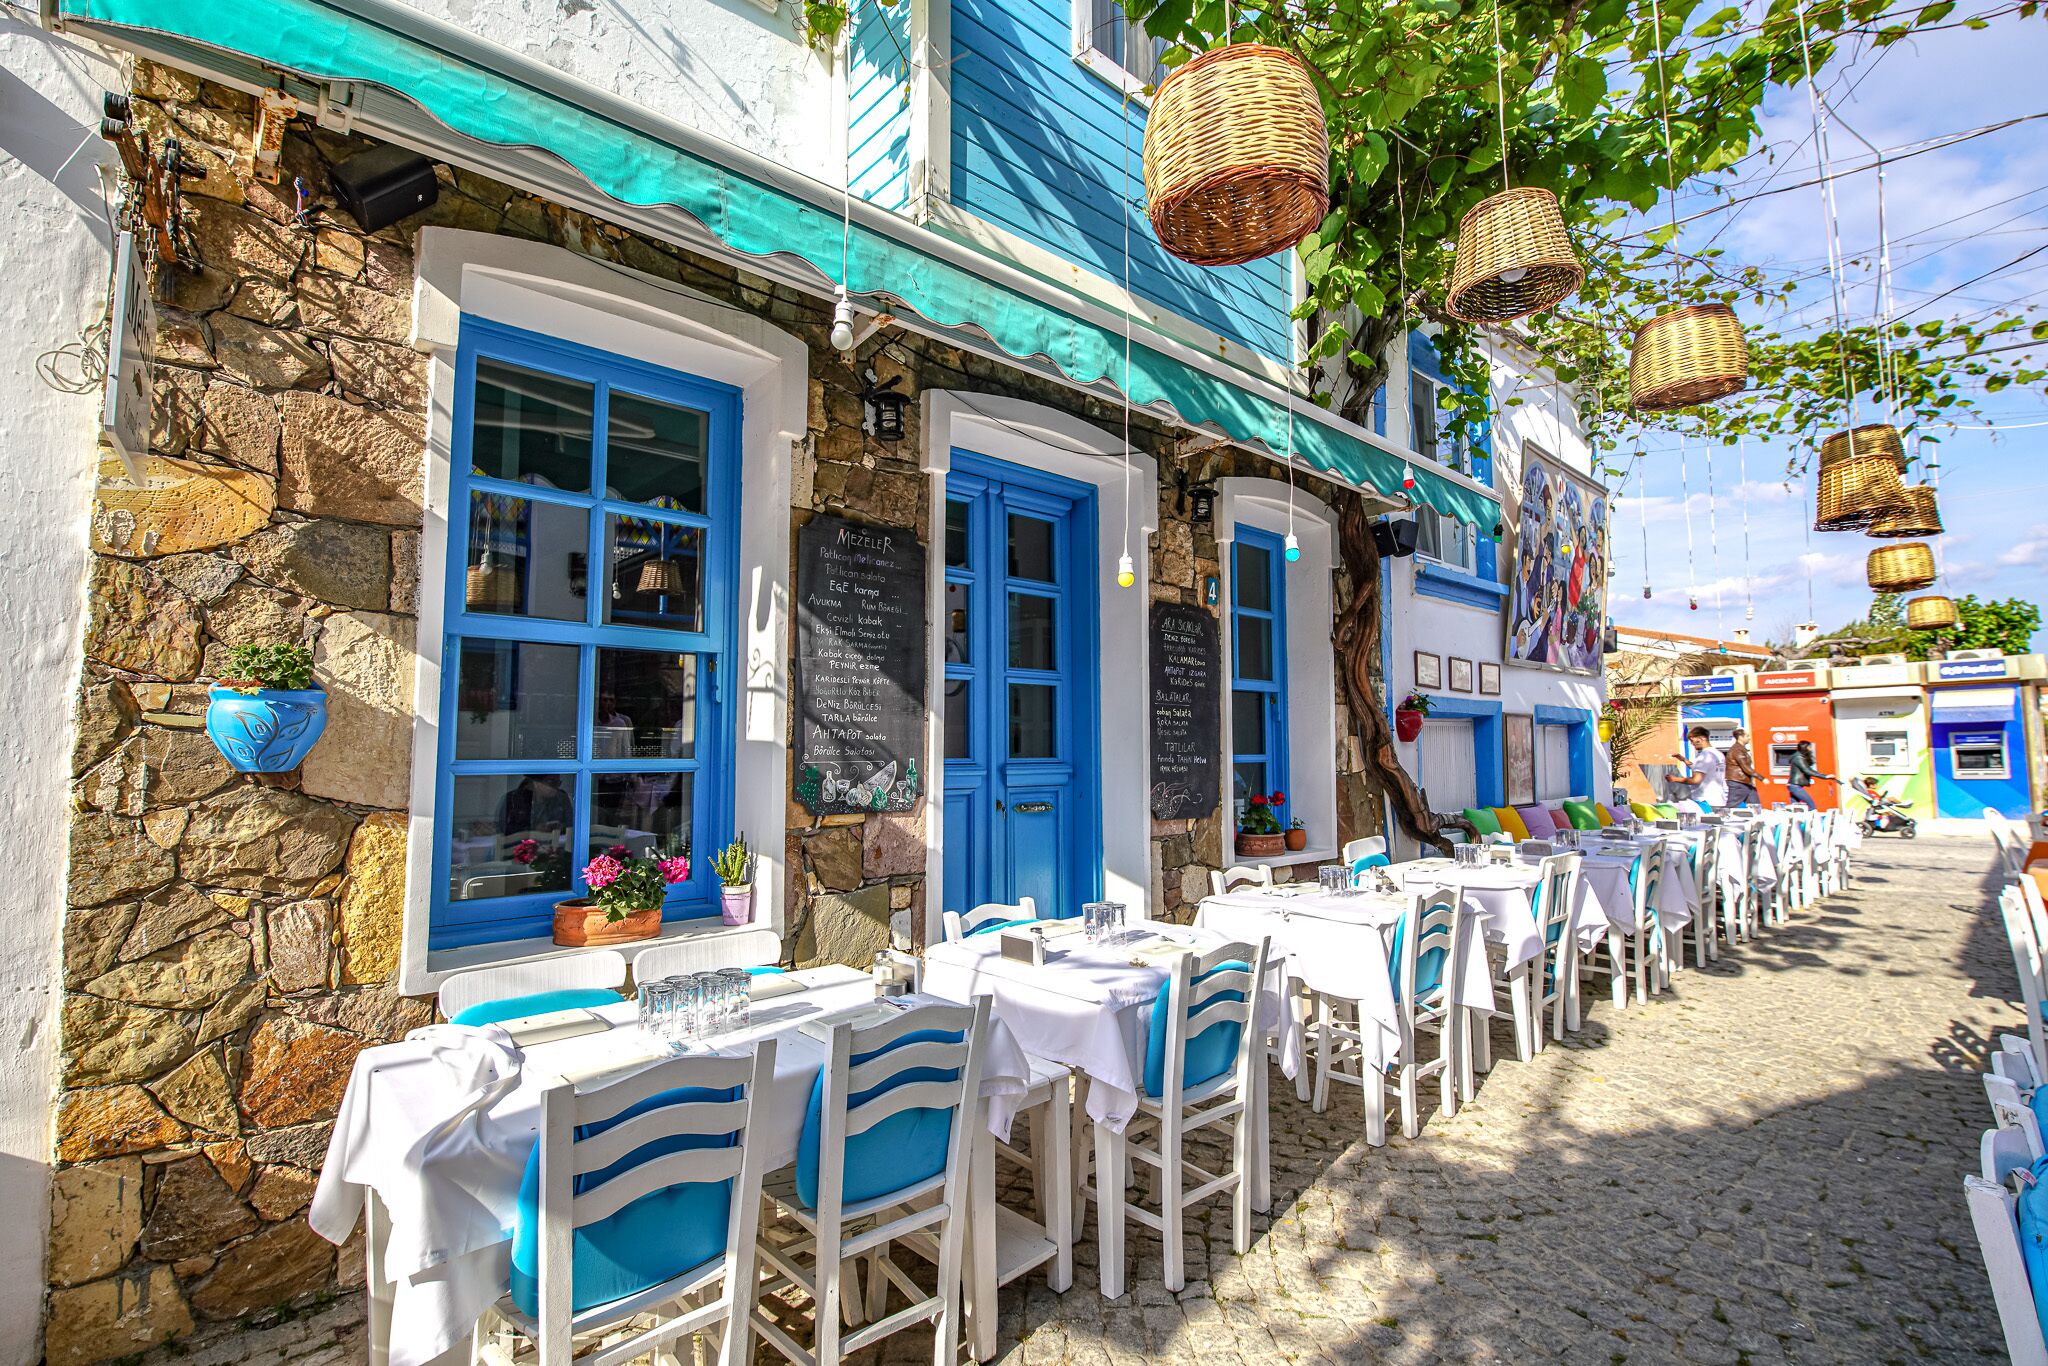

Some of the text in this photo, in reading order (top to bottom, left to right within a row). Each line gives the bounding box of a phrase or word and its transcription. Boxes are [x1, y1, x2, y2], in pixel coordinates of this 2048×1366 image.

[837, 529, 895, 554] MEZELER
[829, 580, 849, 594] EGE
[1209, 582, 1217, 600] 4
[822, 713, 851, 723] TARLA
